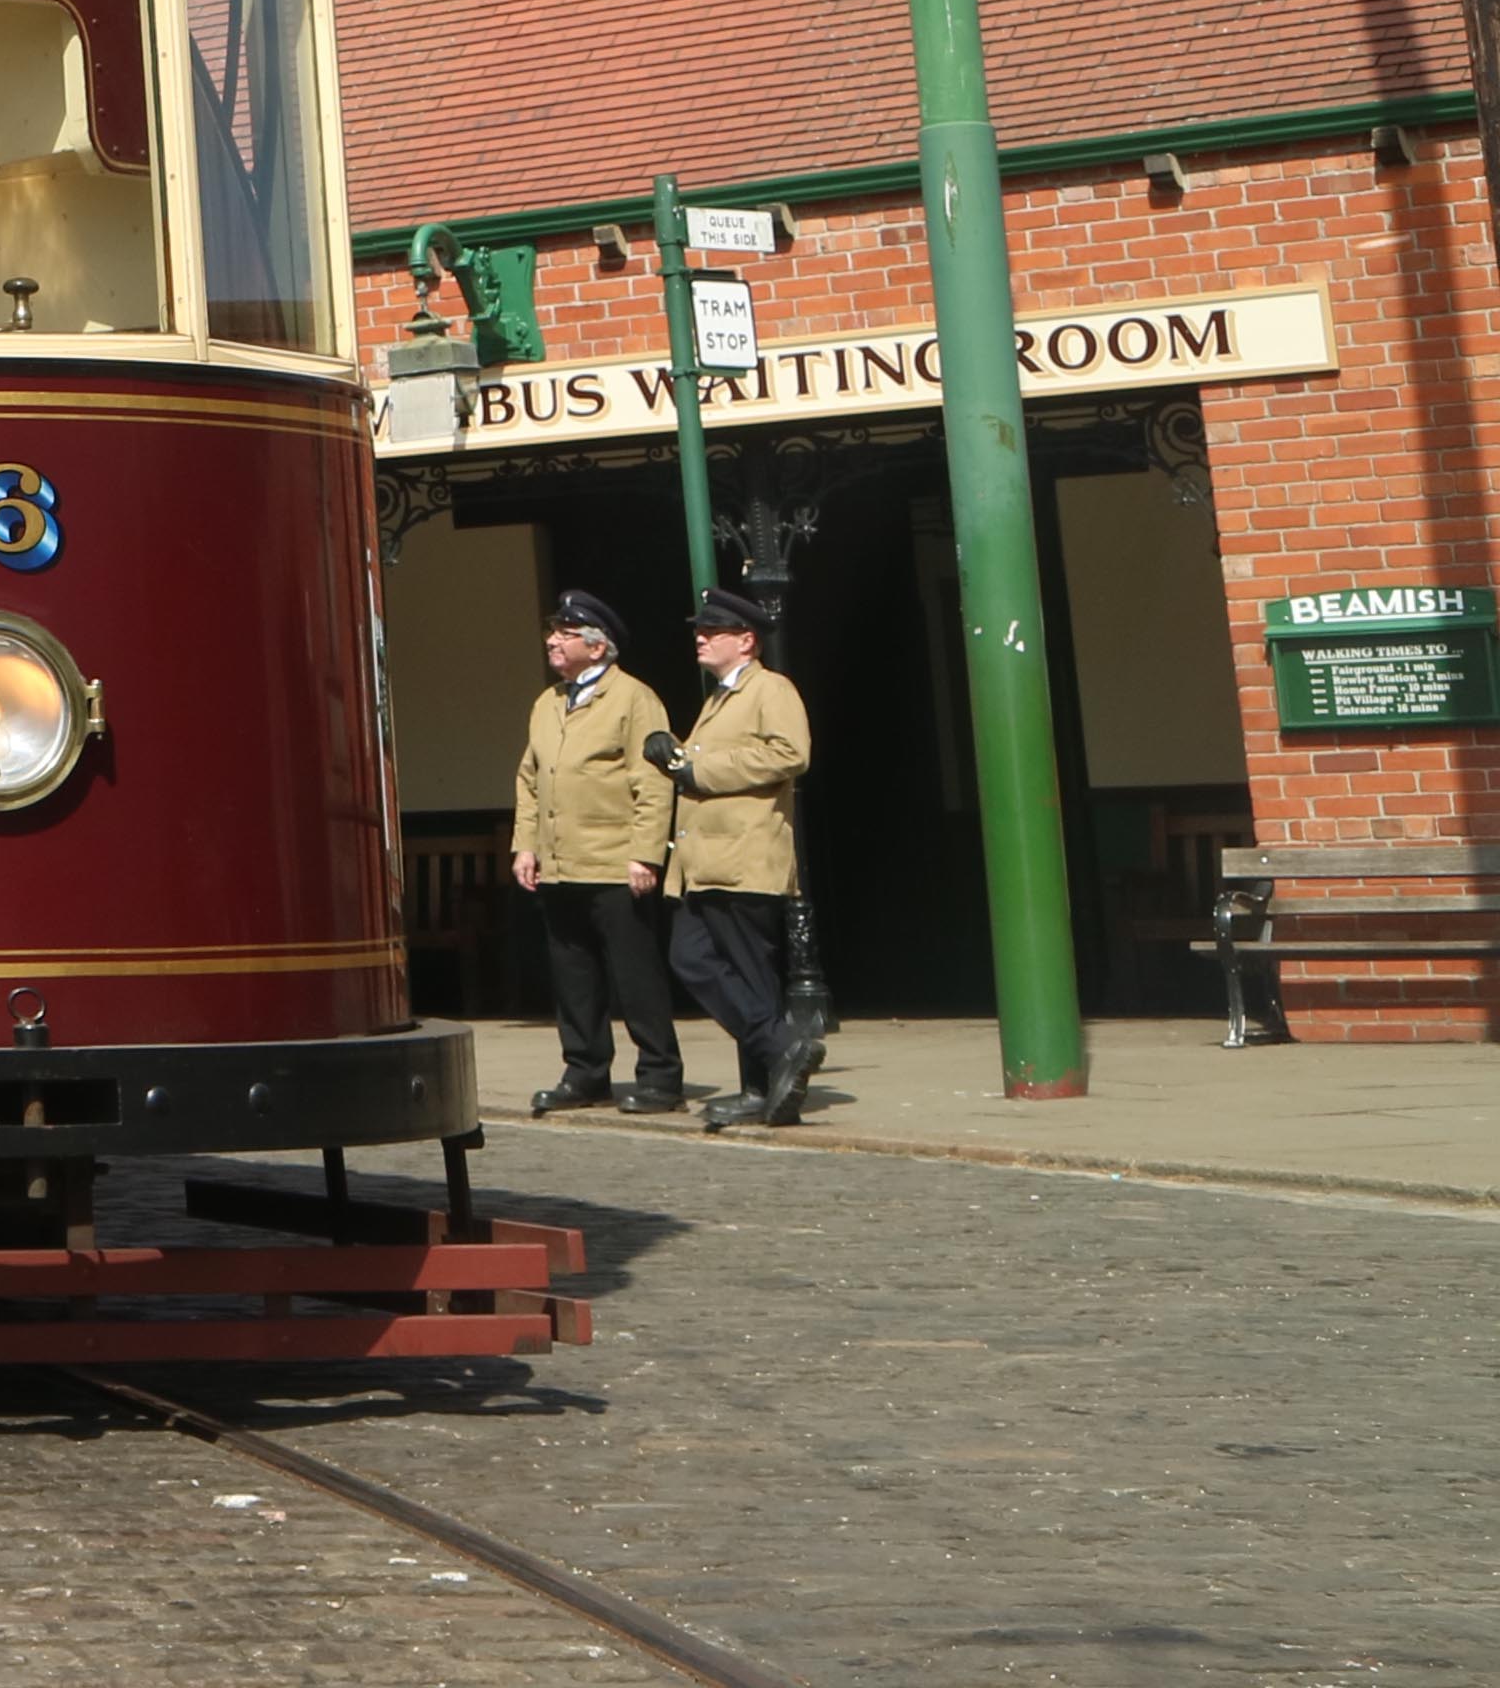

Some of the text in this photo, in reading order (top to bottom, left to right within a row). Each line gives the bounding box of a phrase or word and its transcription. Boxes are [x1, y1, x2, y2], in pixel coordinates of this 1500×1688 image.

[709, 216, 746, 228] QUEUE
[701, 232, 757, 246] THIS SIDE
[700, 300, 747, 317] TRAM
[705, 332, 748, 350] STOP
[1290, 589, 1464, 624] BEAMISH
[1302, 643, 1448, 661] WALKING TIMES TO
[1331, 664, 1394, 676] Fairground
[1413, 662, 1435, 672] min
[1333, 675, 1375, 685] Rowley
[1378, 673, 1418, 683] Station
[1437, 671, 1464, 681] mins
[1334, 685, 1366, 694] Home
[1369, 684, 1399, 694] Farm
[1423, 682, 1450, 692] mins
[1335, 696, 1351, 705] Pit
[1354, 695, 1394, 705] Village
[1419, 692, 1446, 702] mins
[1336, 706, 1387, 716] Entrance
[1411, 703, 1439, 713] mins
